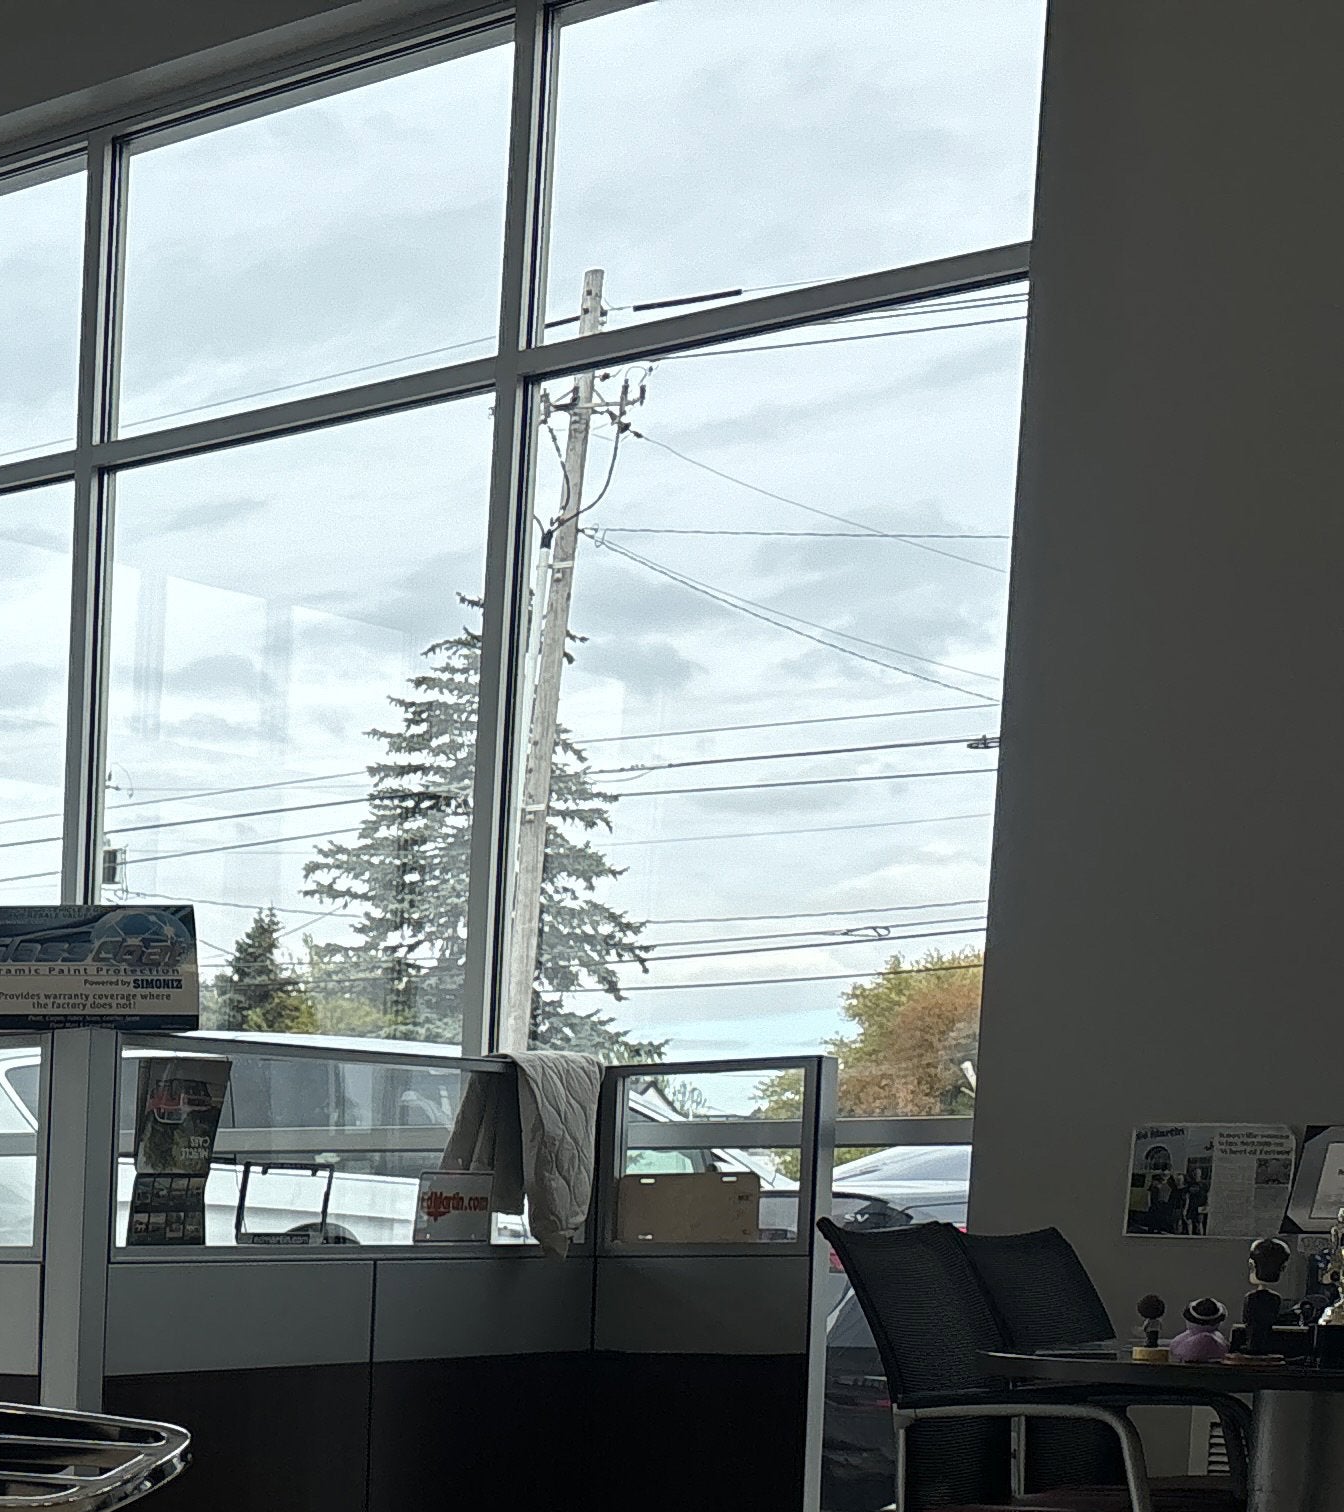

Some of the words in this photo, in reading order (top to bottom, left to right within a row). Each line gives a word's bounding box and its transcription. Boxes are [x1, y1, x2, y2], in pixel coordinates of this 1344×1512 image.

[47, 966, 87, 976] Paint
[95, 966, 181, 976] Protection
[83, 979, 119, 988] Powered
[120, 979, 131, 989] by
[132, 978, 183, 989] SIMONIZ
[43, 993, 90, 1002] warranty
[92, 993, 137, 1002] coverage
[140, 991, 171, 1001] where
[32, 1001, 50, 1010] the
[52, 1001, 87, 1011] factory
[90, 1001, 113, 1010] does
[844, 1213, 869, 1222] SV
